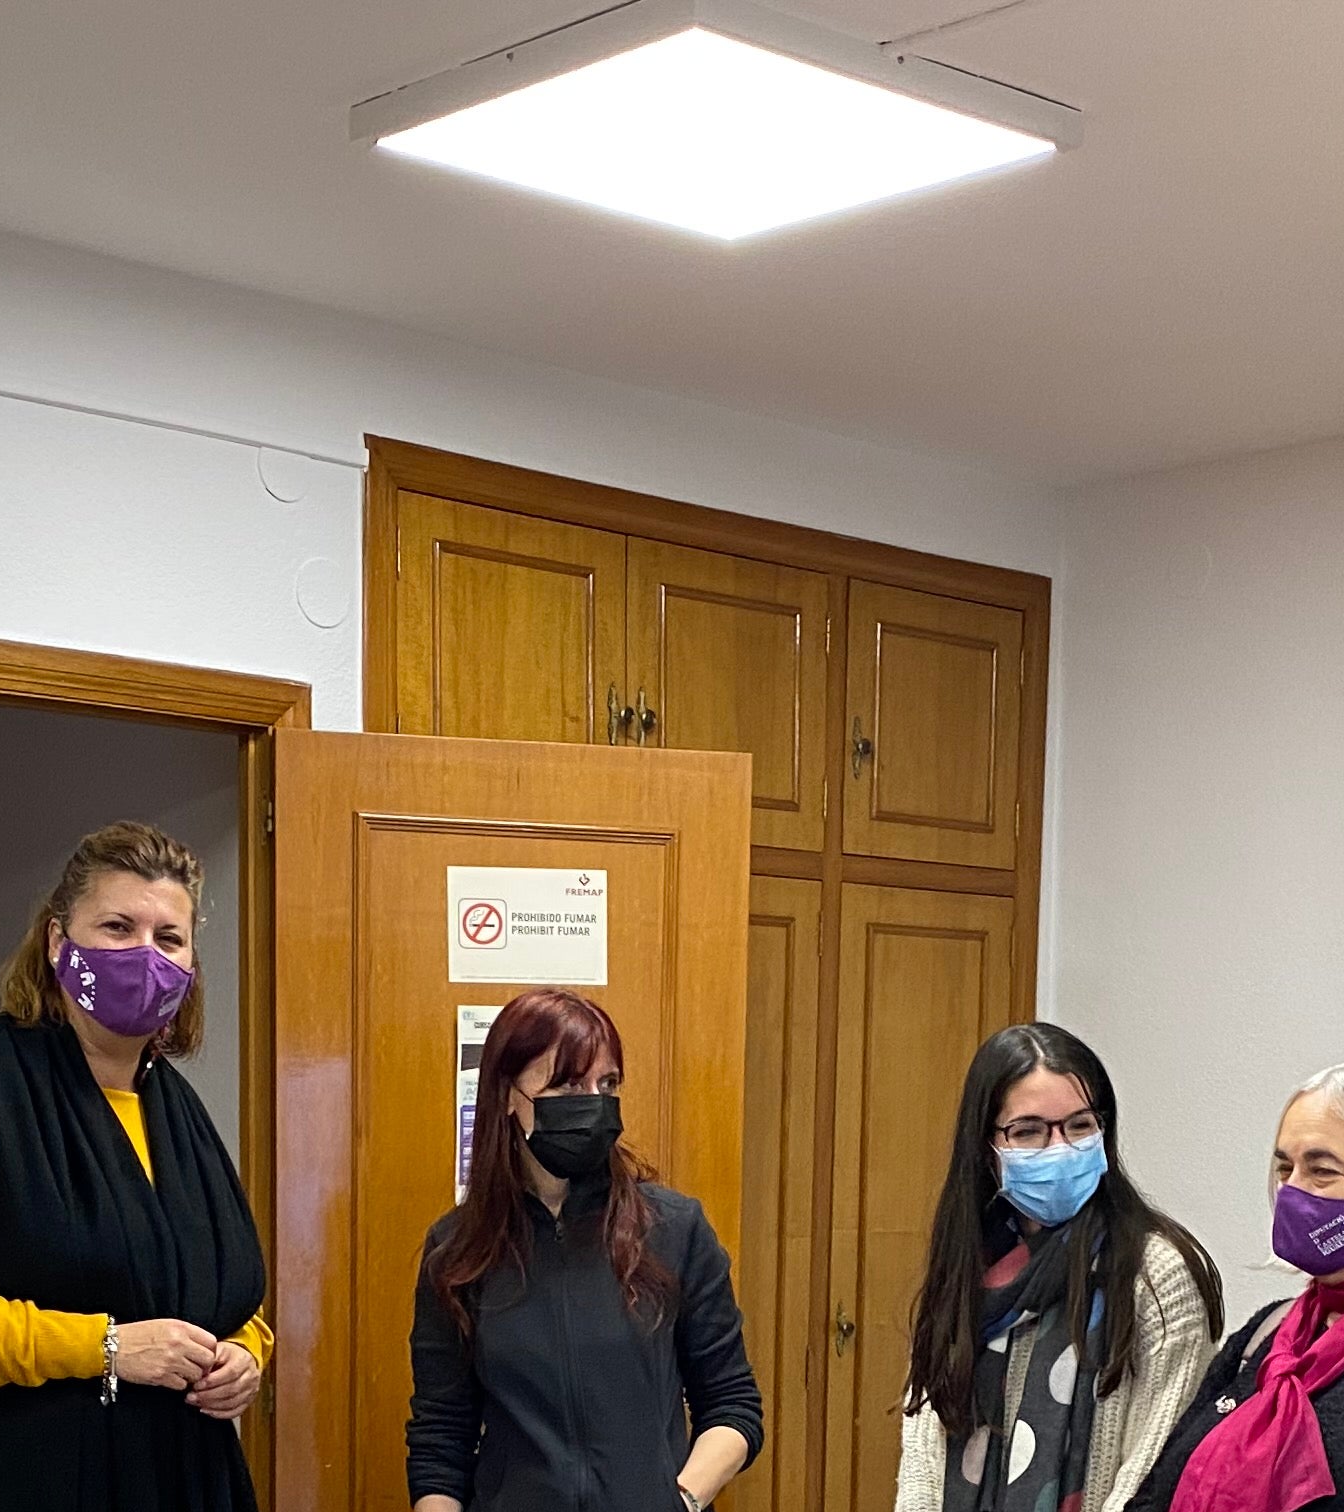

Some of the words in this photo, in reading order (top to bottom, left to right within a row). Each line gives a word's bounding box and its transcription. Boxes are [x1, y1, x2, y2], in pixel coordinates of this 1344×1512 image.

[565, 888, 603, 896] FREMAP
[511, 912, 562, 923] PROHIBIDO
[564, 913, 597, 924] FUMAR
[511, 925, 555, 936] PROHIBIT
[557, 926, 590, 937] FUMAR
